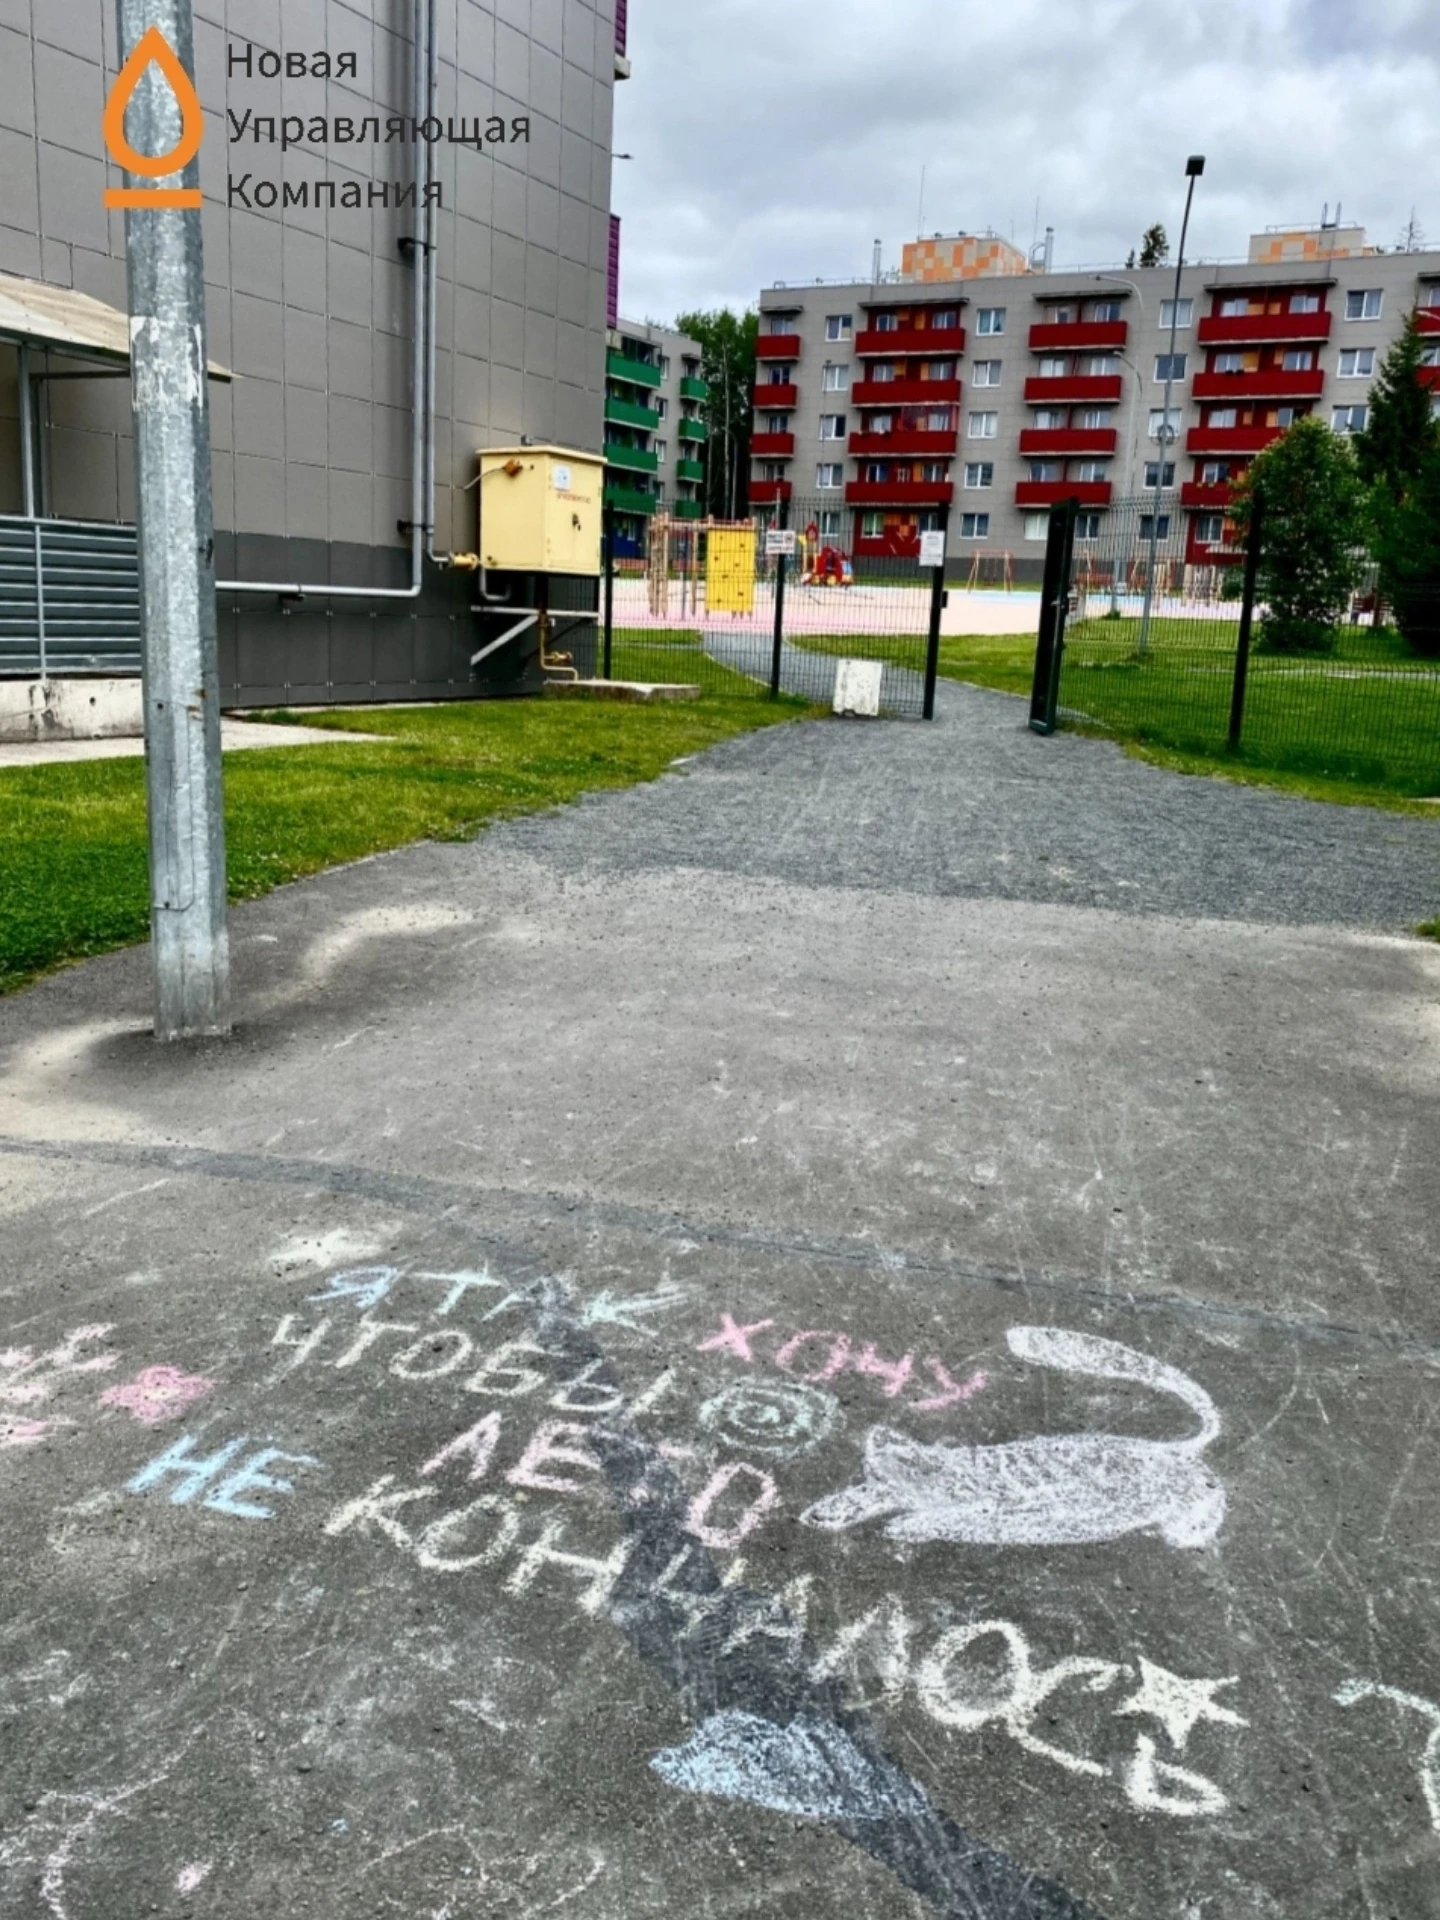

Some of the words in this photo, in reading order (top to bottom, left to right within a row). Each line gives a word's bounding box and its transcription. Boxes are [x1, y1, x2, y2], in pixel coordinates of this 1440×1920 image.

[262, 1311, 679, 1421] ЧТОБЫ
[305, 1265, 402, 1309] Я
[700, 1313, 985, 1408] ХОЧУ
[122, 1433, 328, 1519] НЕ
